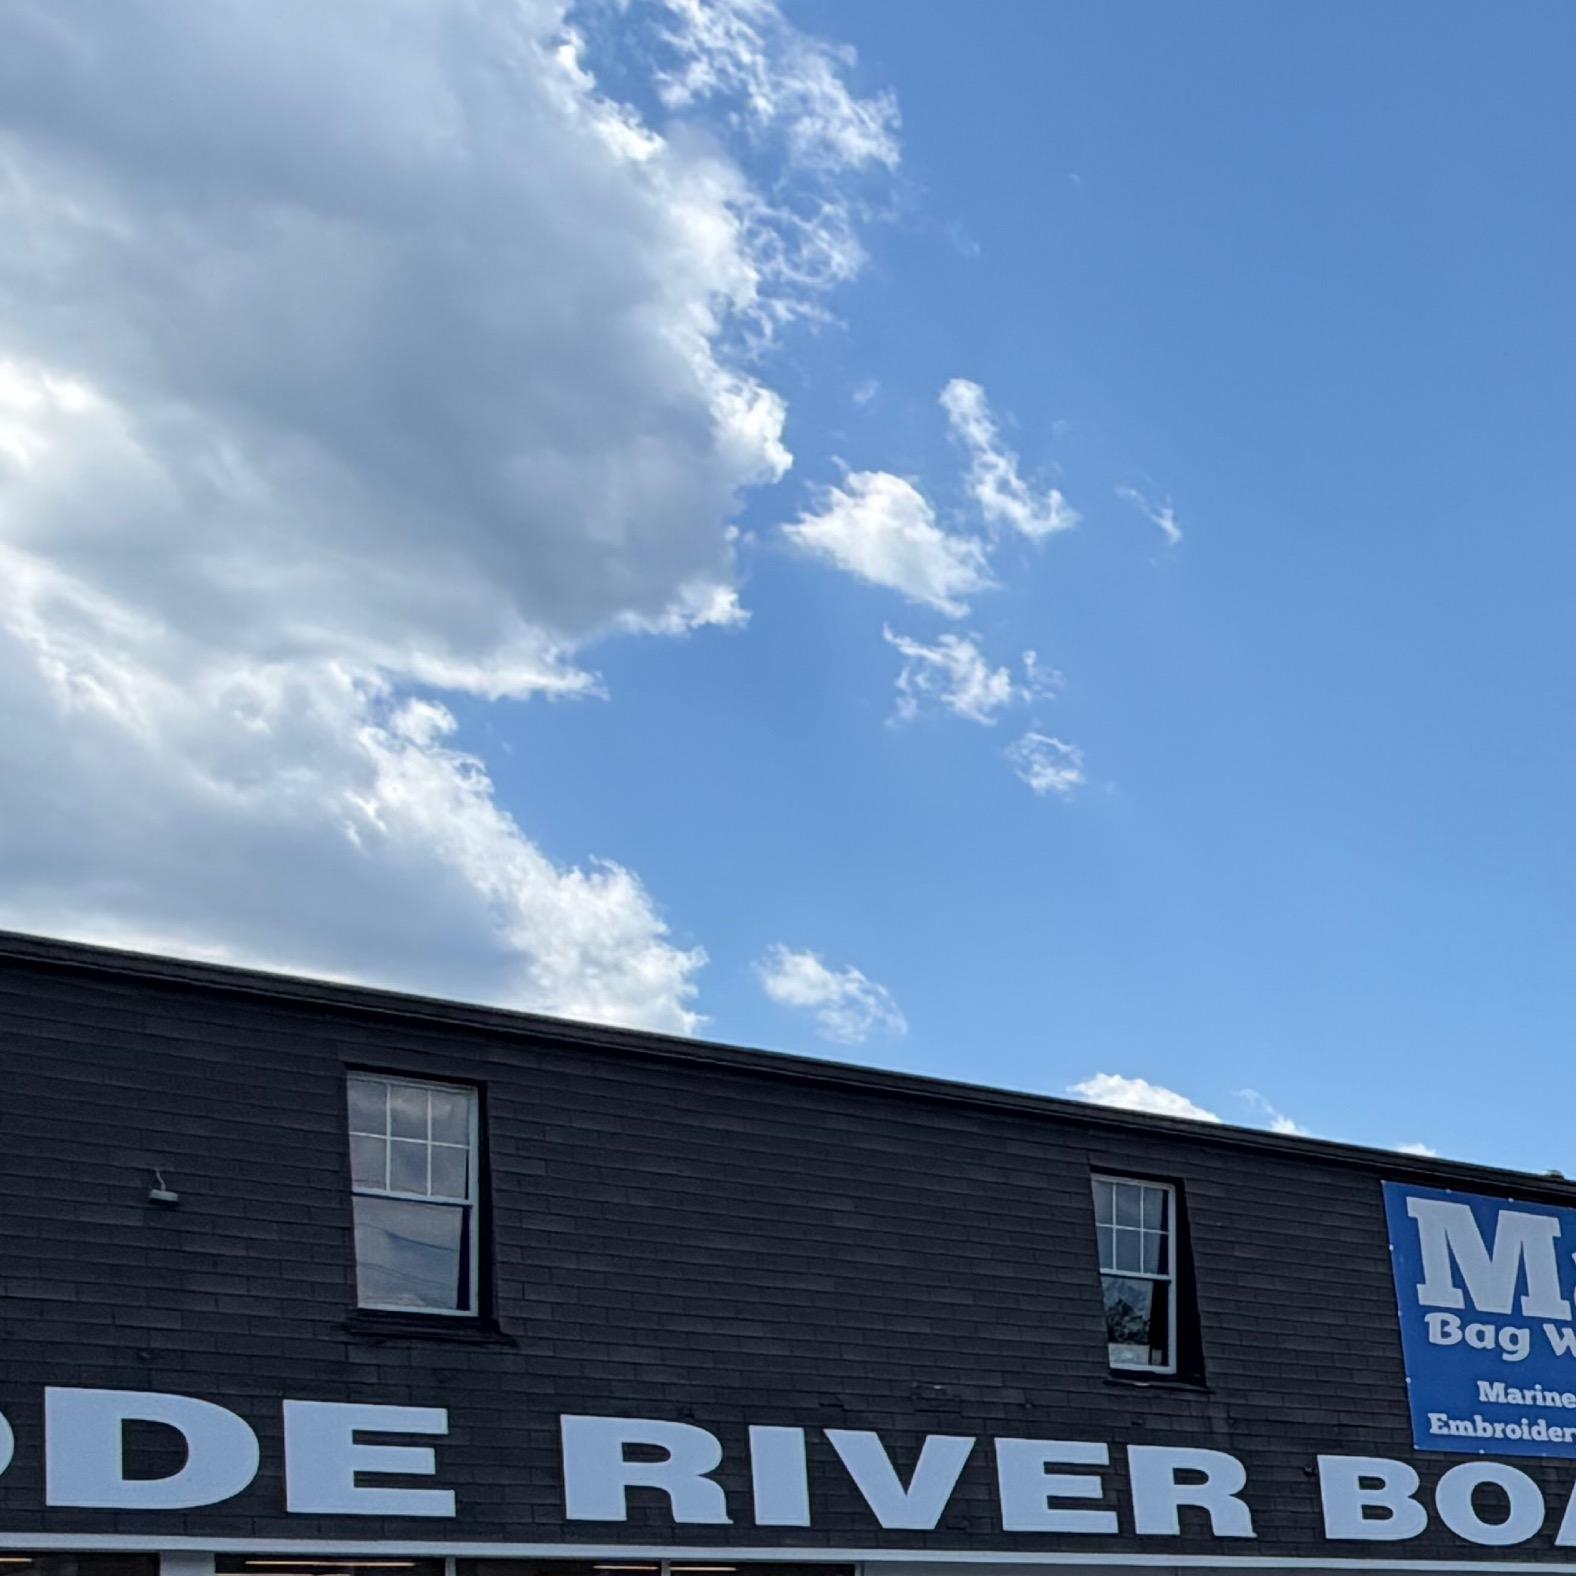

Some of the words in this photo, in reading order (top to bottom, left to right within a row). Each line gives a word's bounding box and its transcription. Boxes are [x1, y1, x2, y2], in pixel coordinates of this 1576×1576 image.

[1424, 1312, 1531, 1362] Bag
[1477, 1380, 1576, 1410] Marine
[0, 1386, 457, 1518] DE
[559, 1414, 1258, 1539] RIVER
